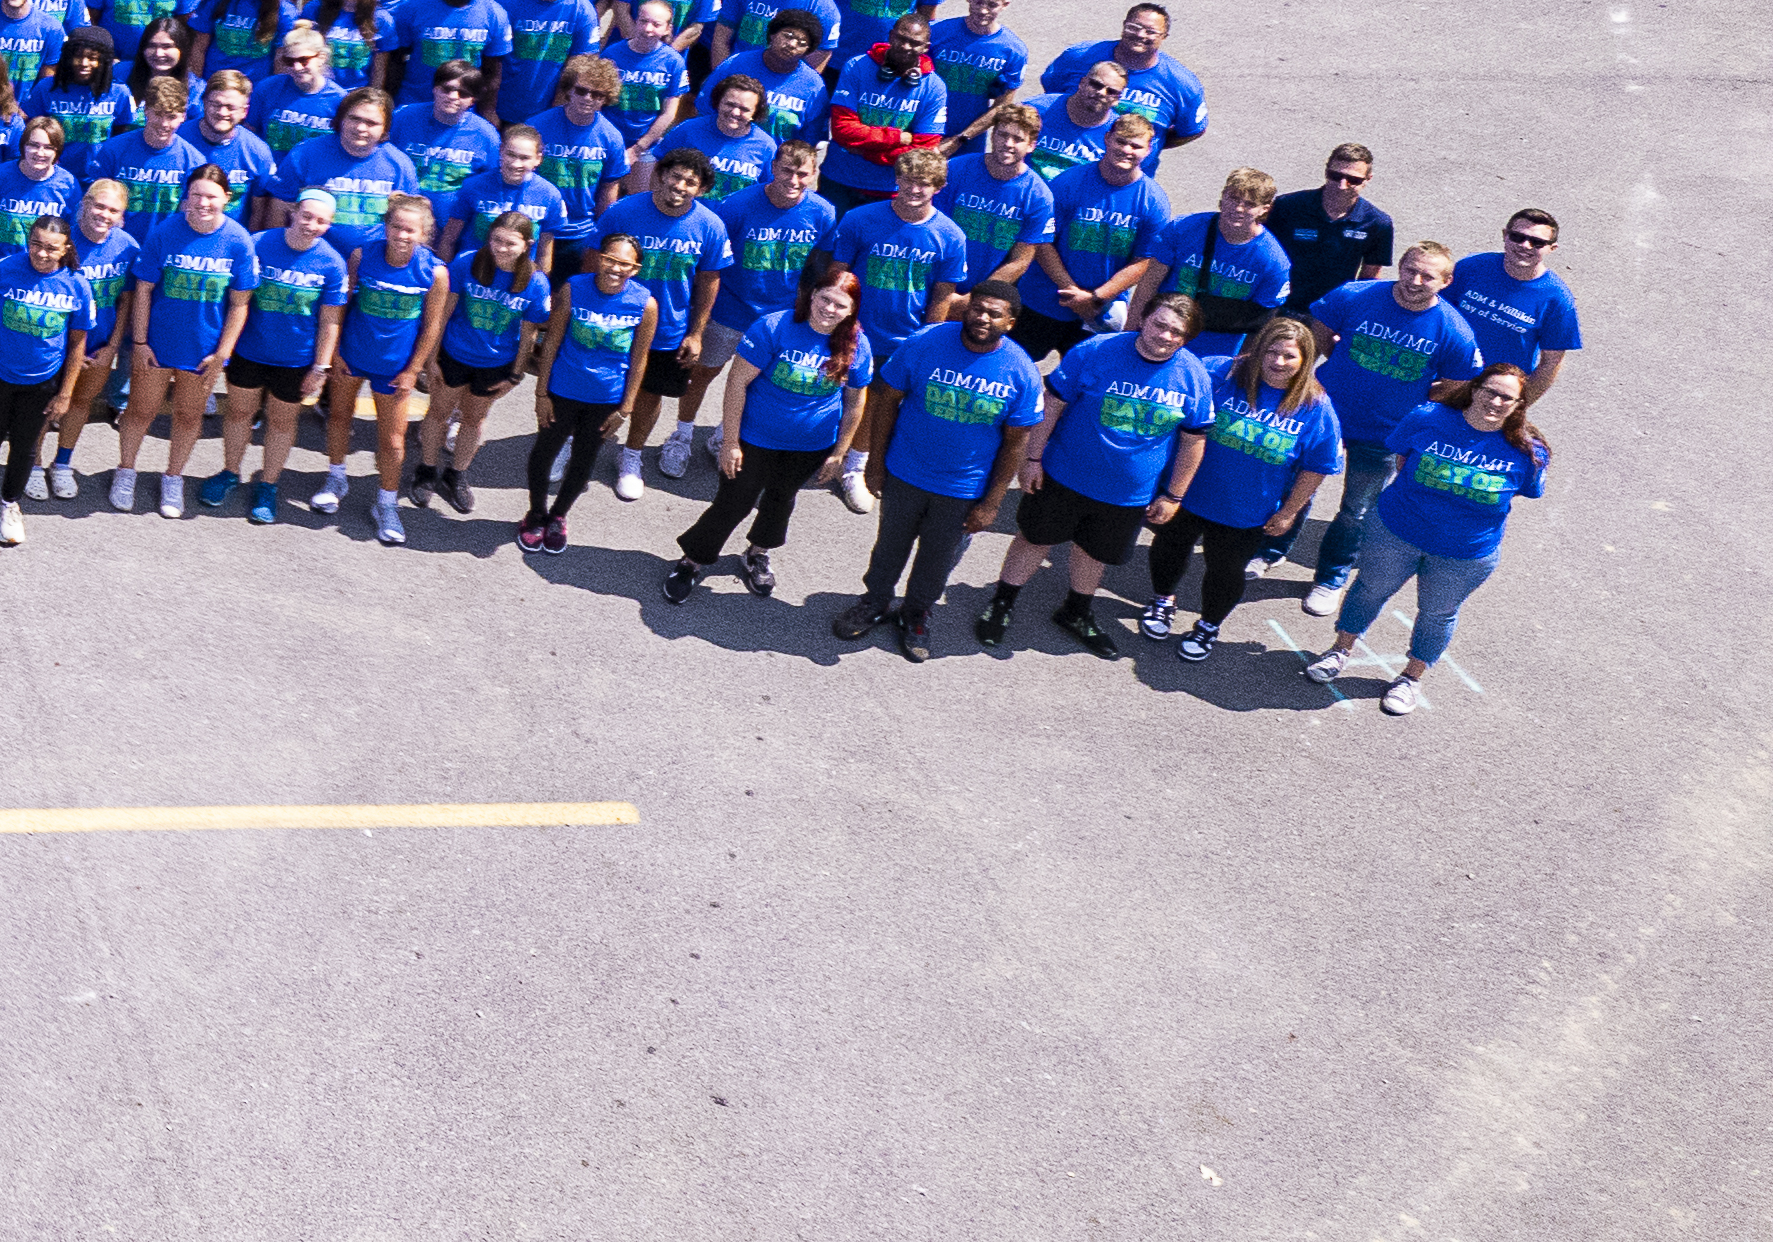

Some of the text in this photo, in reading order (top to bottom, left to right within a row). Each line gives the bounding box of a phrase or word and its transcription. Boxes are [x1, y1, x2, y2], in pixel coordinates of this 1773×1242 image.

[937, 48, 1006, 72] ADM/MU
[1186, 253, 1258, 284] AM/MU
[3, 288, 82, 310] ADM/MU
[1465, 290, 1536, 324] ADM & Millikin
[1460, 300, 1527, 333] Day of Service
[1353, 335, 1430, 369] DAY OF
[1356, 321, 1438, 355] ADM/MU
[780, 349, 832, 369] ADM/
[926, 384, 970, 410] DAY
[929, 368, 1011, 399] ADM/MU
[1106, 380, 1187, 408] ADM/MU
[1216, 408, 1297, 453] DAY OF
[1222, 397, 1304, 435] ADM/MU
[1419, 455, 1507, 492] DAY OF
